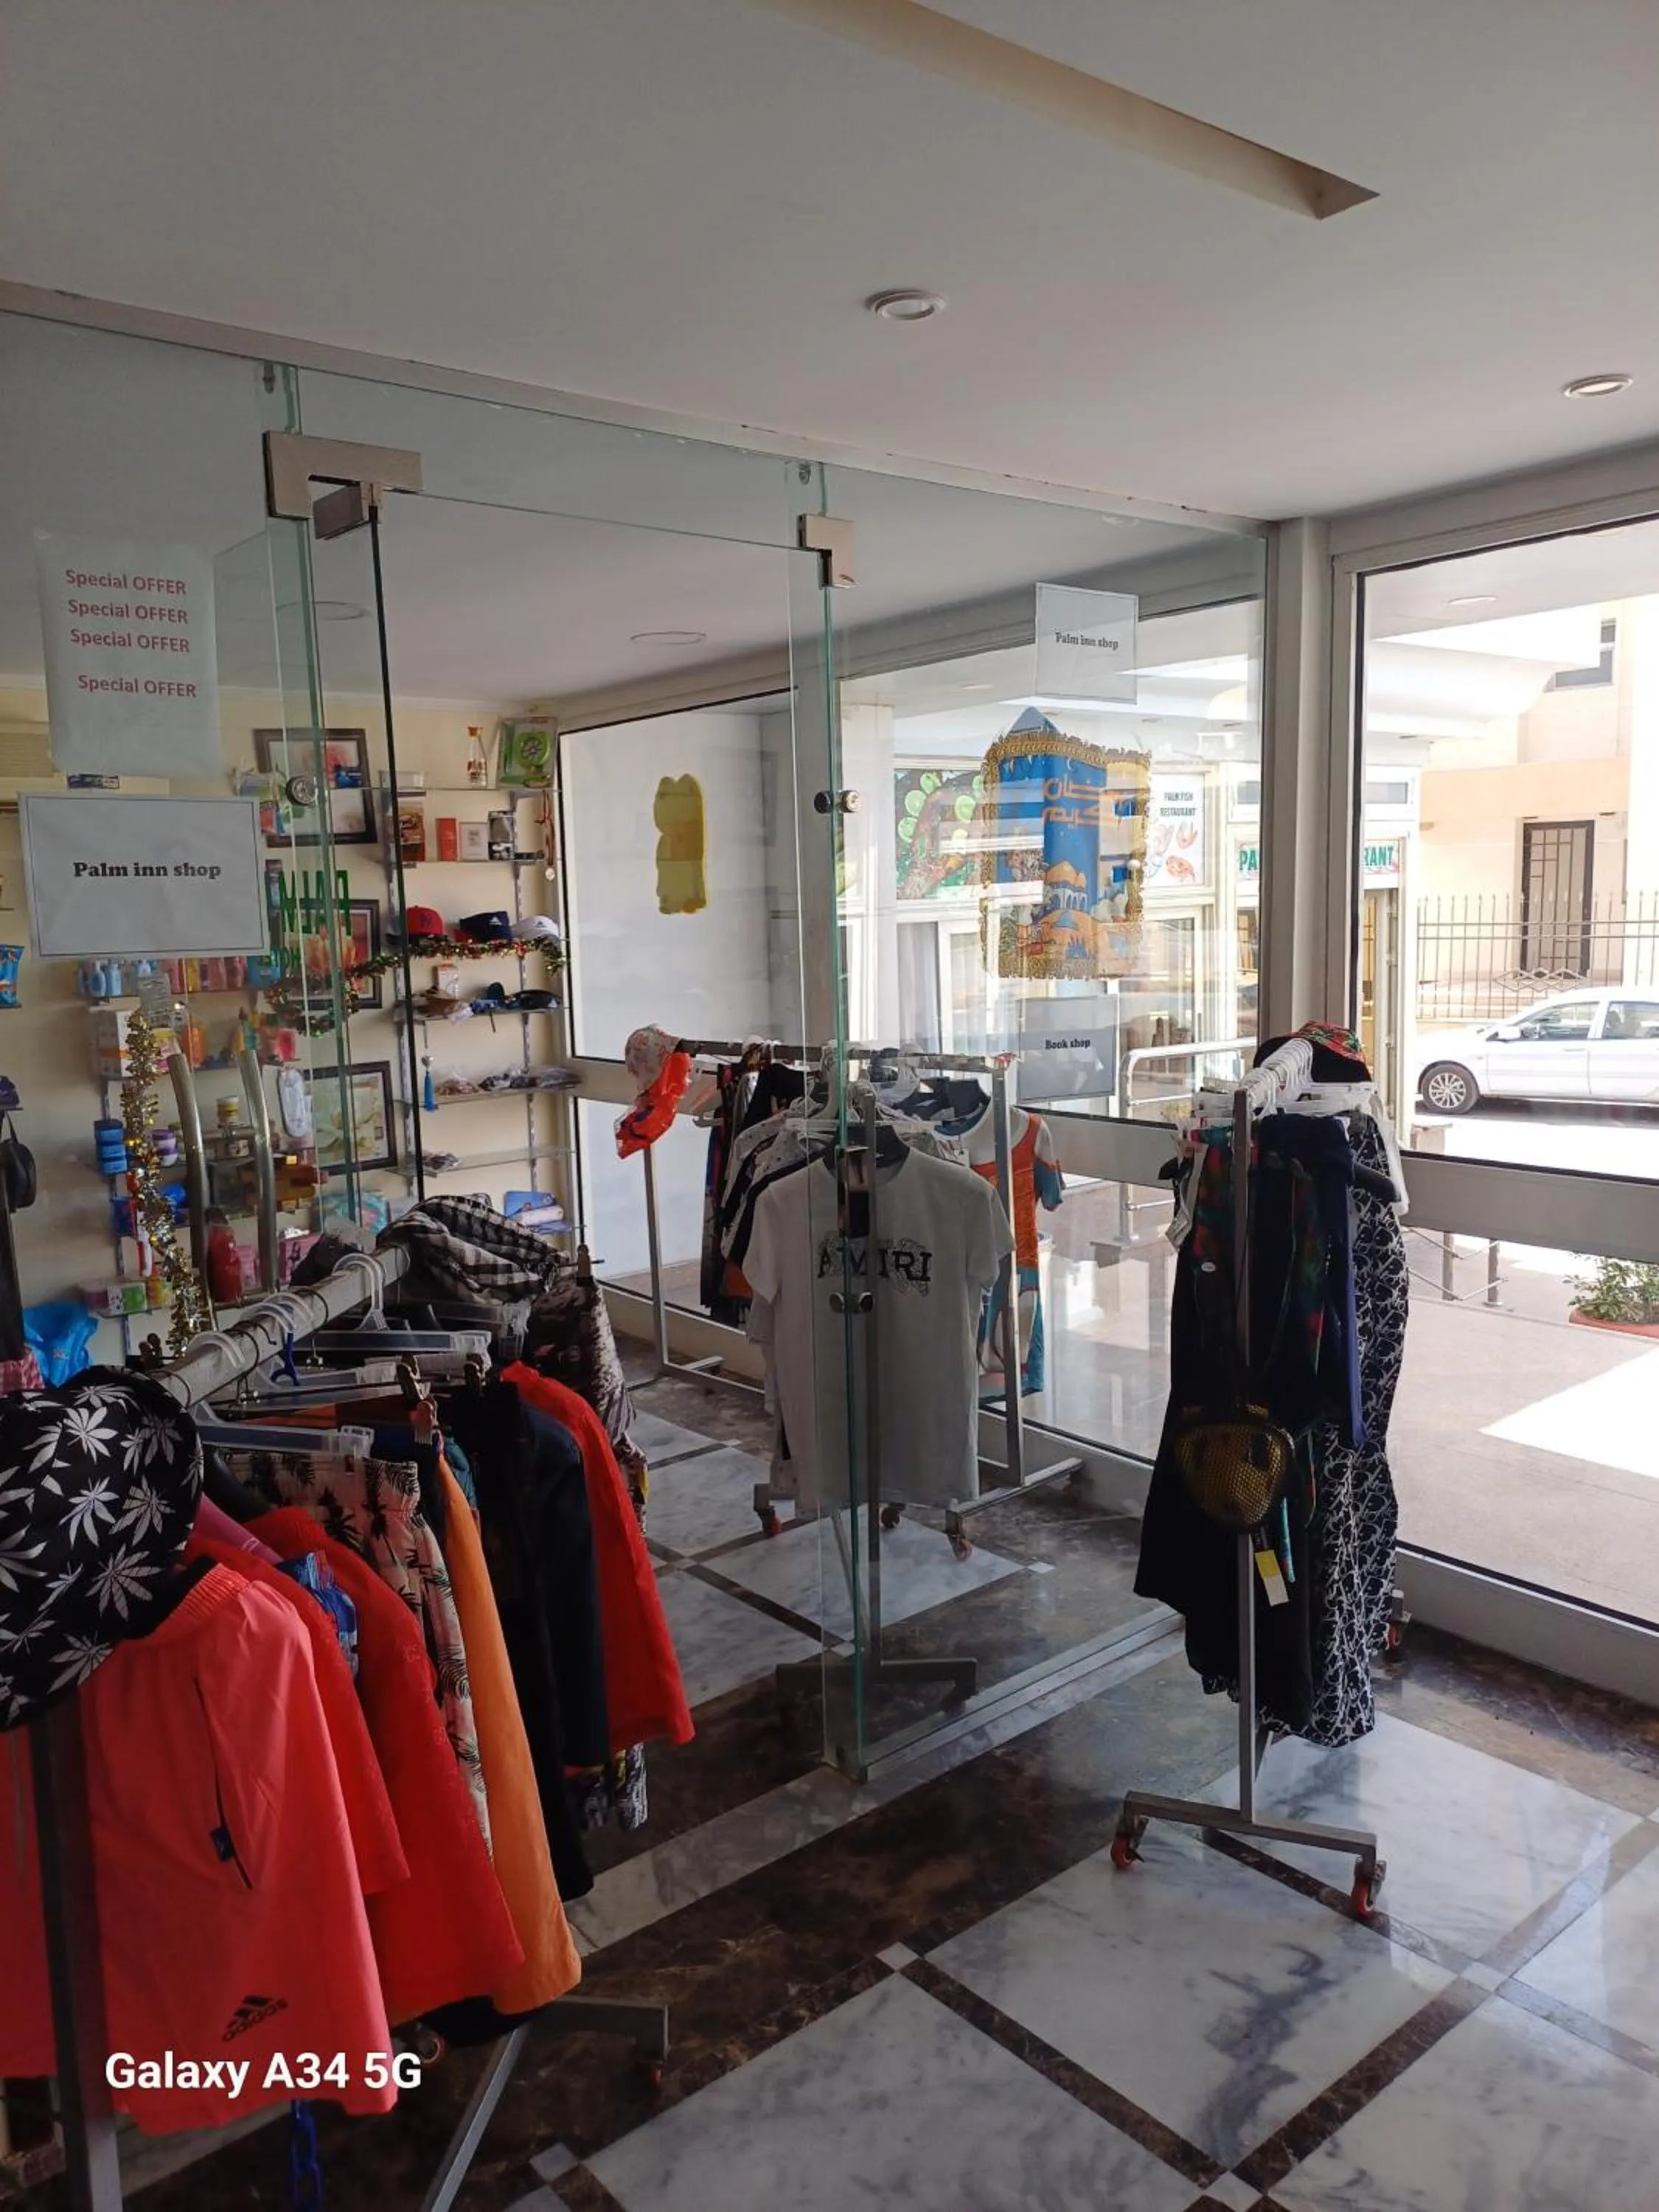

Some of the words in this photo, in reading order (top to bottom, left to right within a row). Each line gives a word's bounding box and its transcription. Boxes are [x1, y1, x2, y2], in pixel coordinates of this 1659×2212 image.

[65, 569, 128, 588] Special
[133, 576, 187, 595] OFFER
[68, 599, 130, 619] Special
[135, 605, 189, 625] OFFER
[70, 628, 131, 647] Special
[137, 635, 189, 653] OFFER
[1055, 632, 1079, 644] Palm
[1098, 637, 1119, 650] shop
[77, 675, 139, 692] Special
[144, 680, 197, 698] OFFER
[74, 862, 128, 877] Palm
[133, 861, 168, 877] inn
[173, 862, 221, 879] shop
[1239, 849, 1258, 870] PA
[1045, 1039, 1068, 1049] Book
[1070, 1037, 1091, 1048] shop
